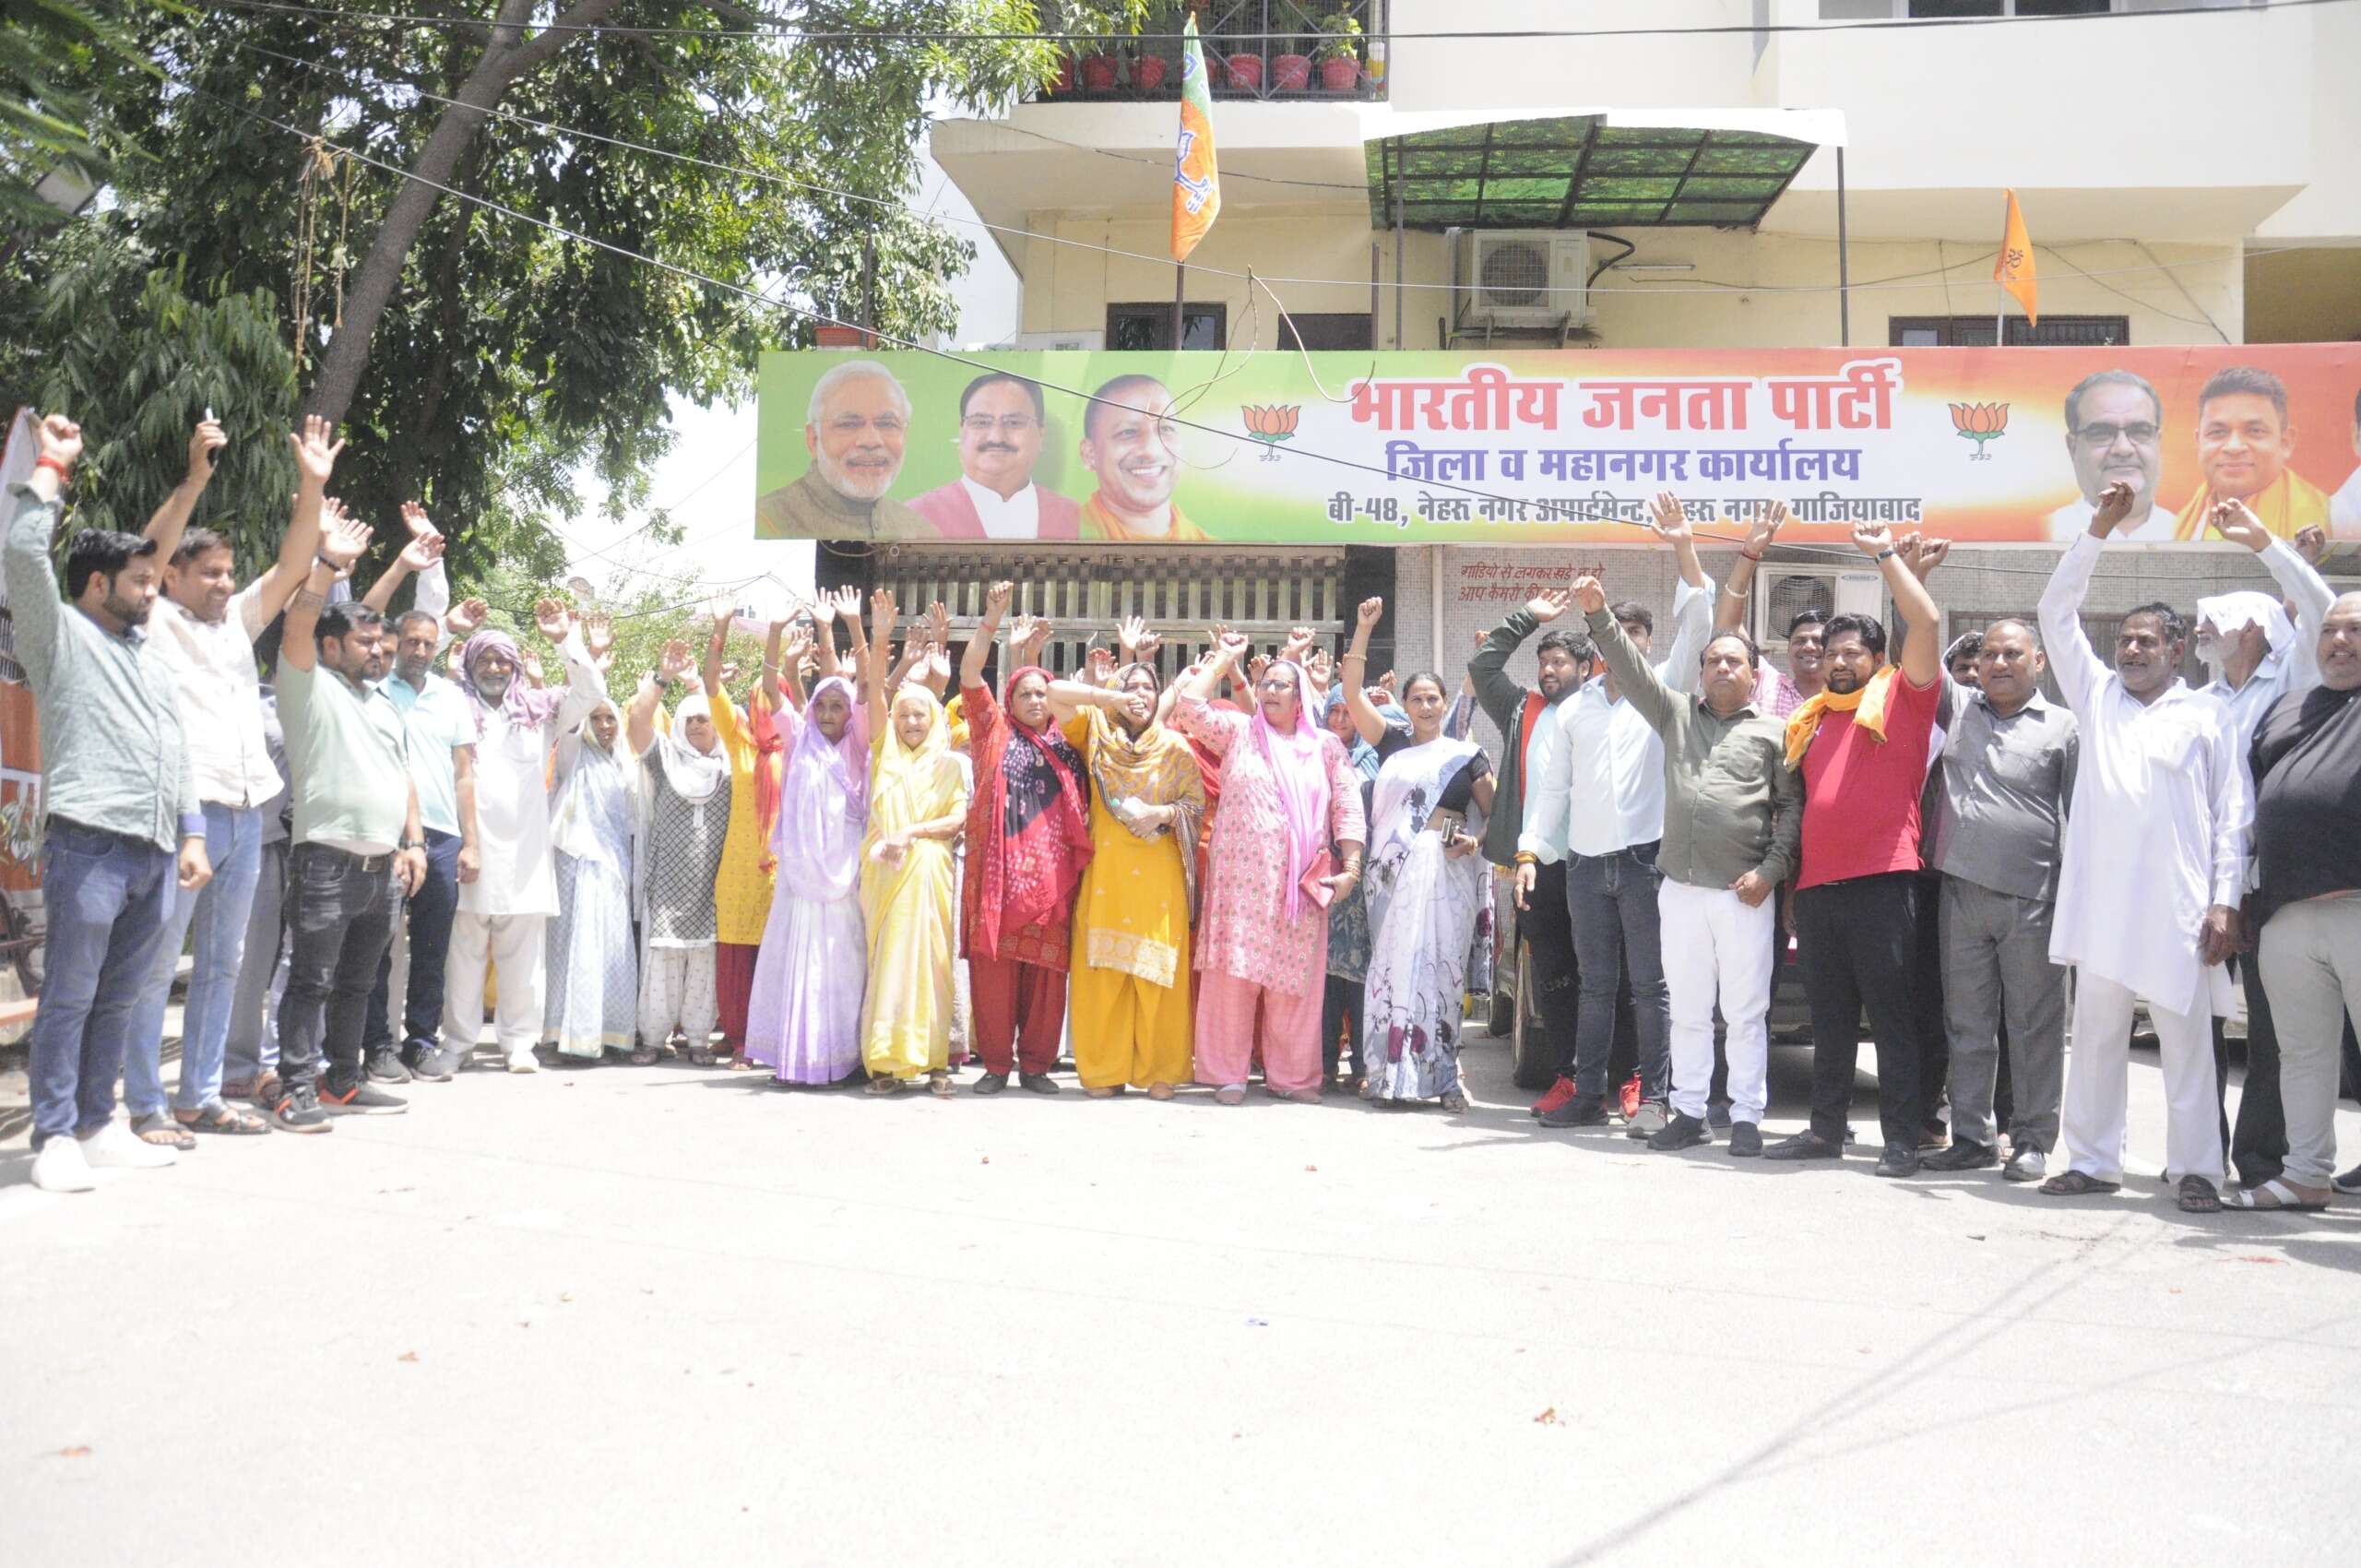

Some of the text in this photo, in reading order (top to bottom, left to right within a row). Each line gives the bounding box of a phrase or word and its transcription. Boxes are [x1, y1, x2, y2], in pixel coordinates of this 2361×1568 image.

[1350, 362, 1896, 431] भारतीय जनता पार्टी
[1384, 437, 1862, 481] जिला व महानगर कार्यालय
[1327, 491, 1408, 527] बी-48,
[1477, 498, 1529, 522] नगर
[1666, 491, 1716, 522] हरू
[1791, 491, 1922, 521] गाजियाबाद
[1501, 563, 1514, 579] से
[1459, 586, 1488, 601] आप
